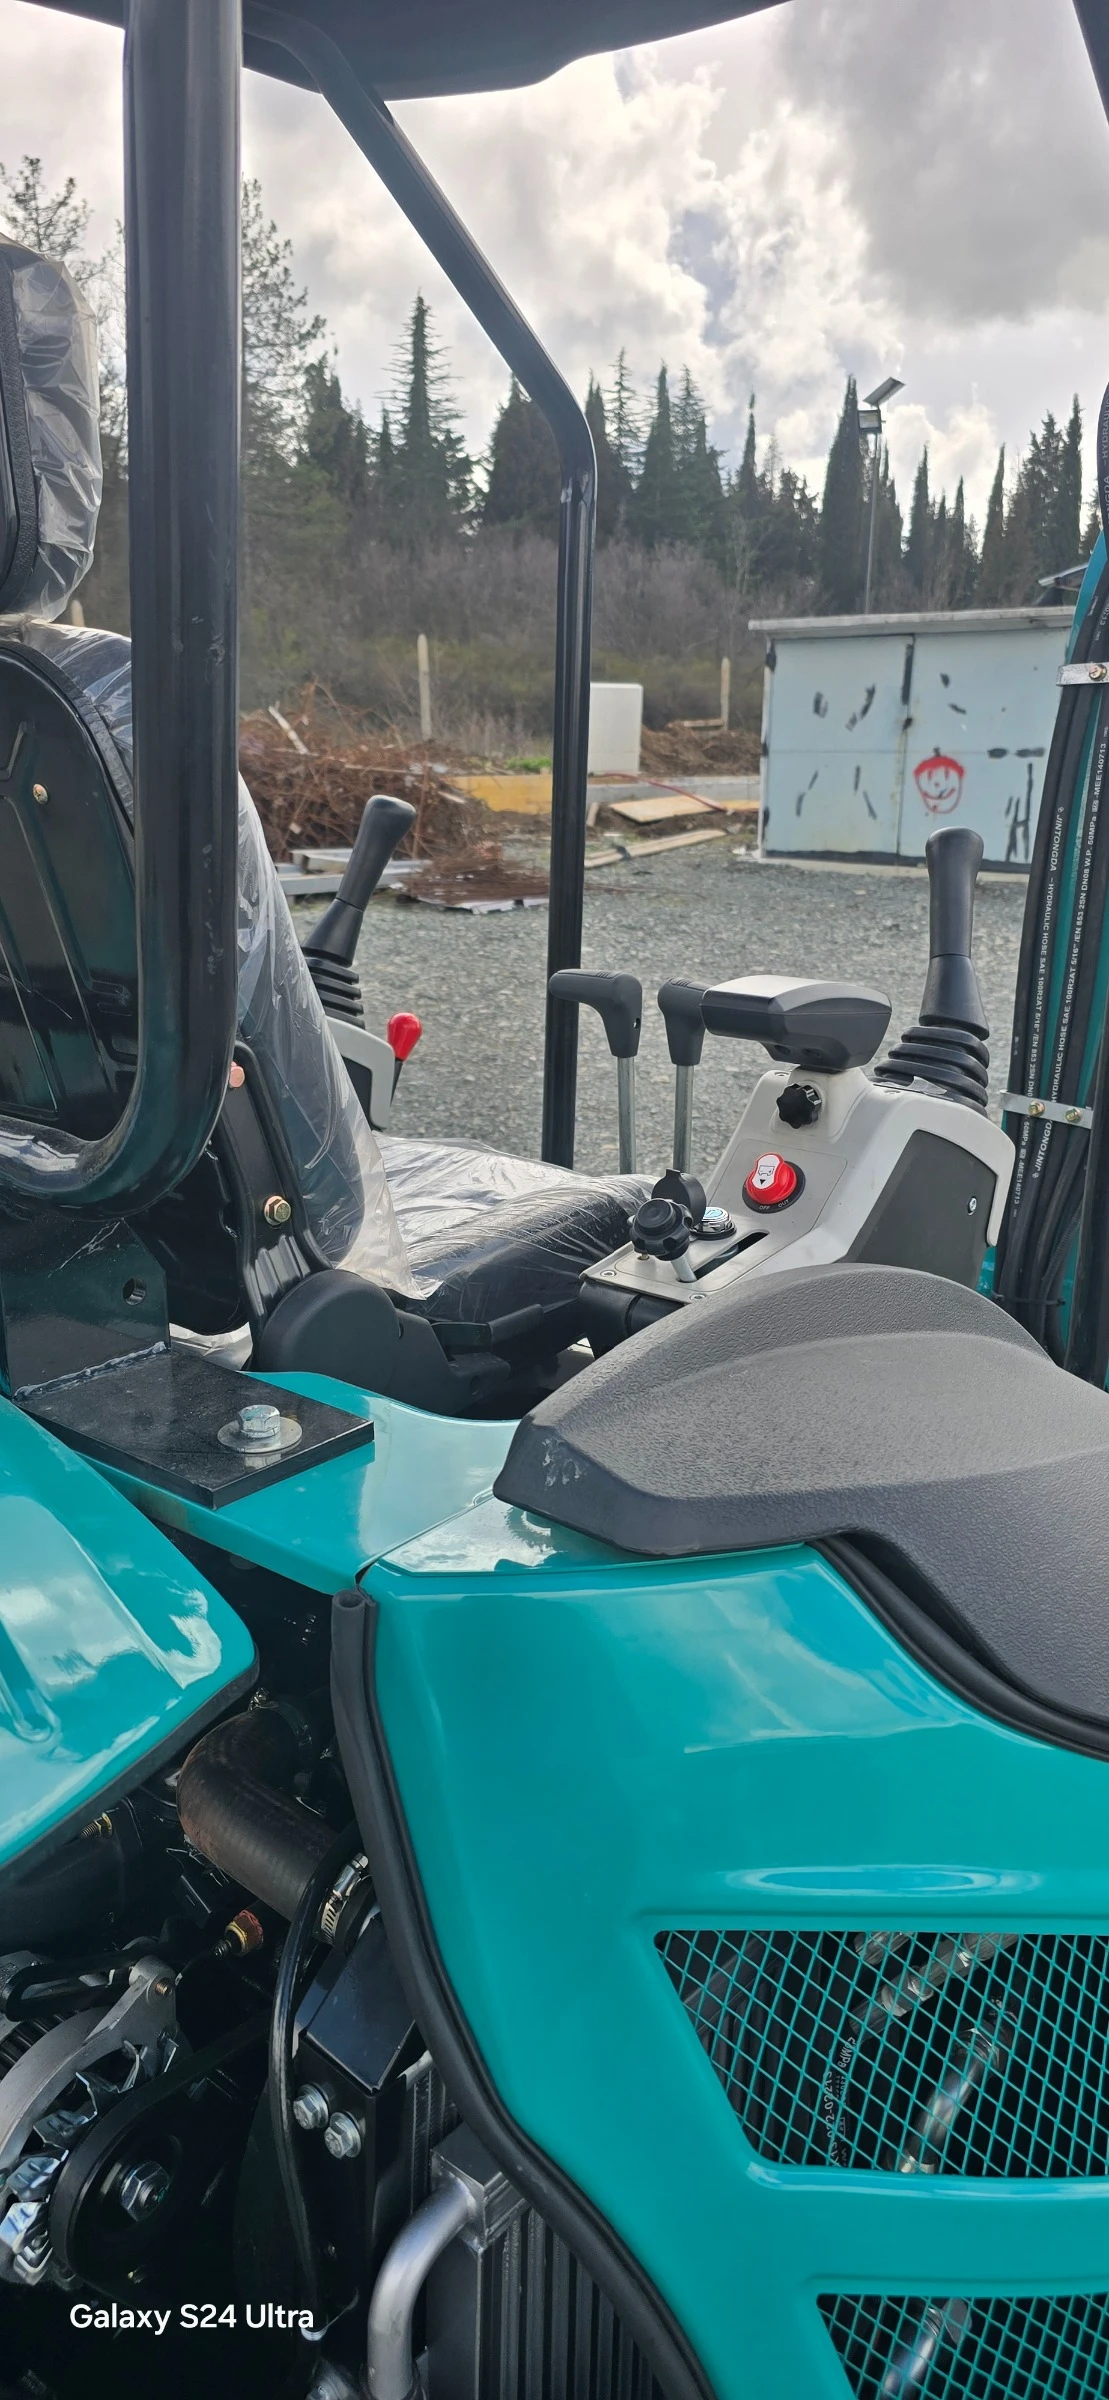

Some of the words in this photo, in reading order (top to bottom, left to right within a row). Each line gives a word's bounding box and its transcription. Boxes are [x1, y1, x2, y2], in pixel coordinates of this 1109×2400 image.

[1050, 814, 1063, 872] JINTONGDA
[1079, 892, 1087, 910] 2SN
[1076, 911, 1084, 926] 853
[1041, 932, 1049, 956] HOSE
[1035, 977, 1044, 1011] 100R2AT
[1066, 968, 1077, 1003] 100R2AT
[1062, 1005, 1071, 1023] SAE
[1060, 1024, 1068, 1051] HOSE
[1027, 1081, 1035, 1098] DN0
[1035, 1119, 1053, 1171] JINTONGD
